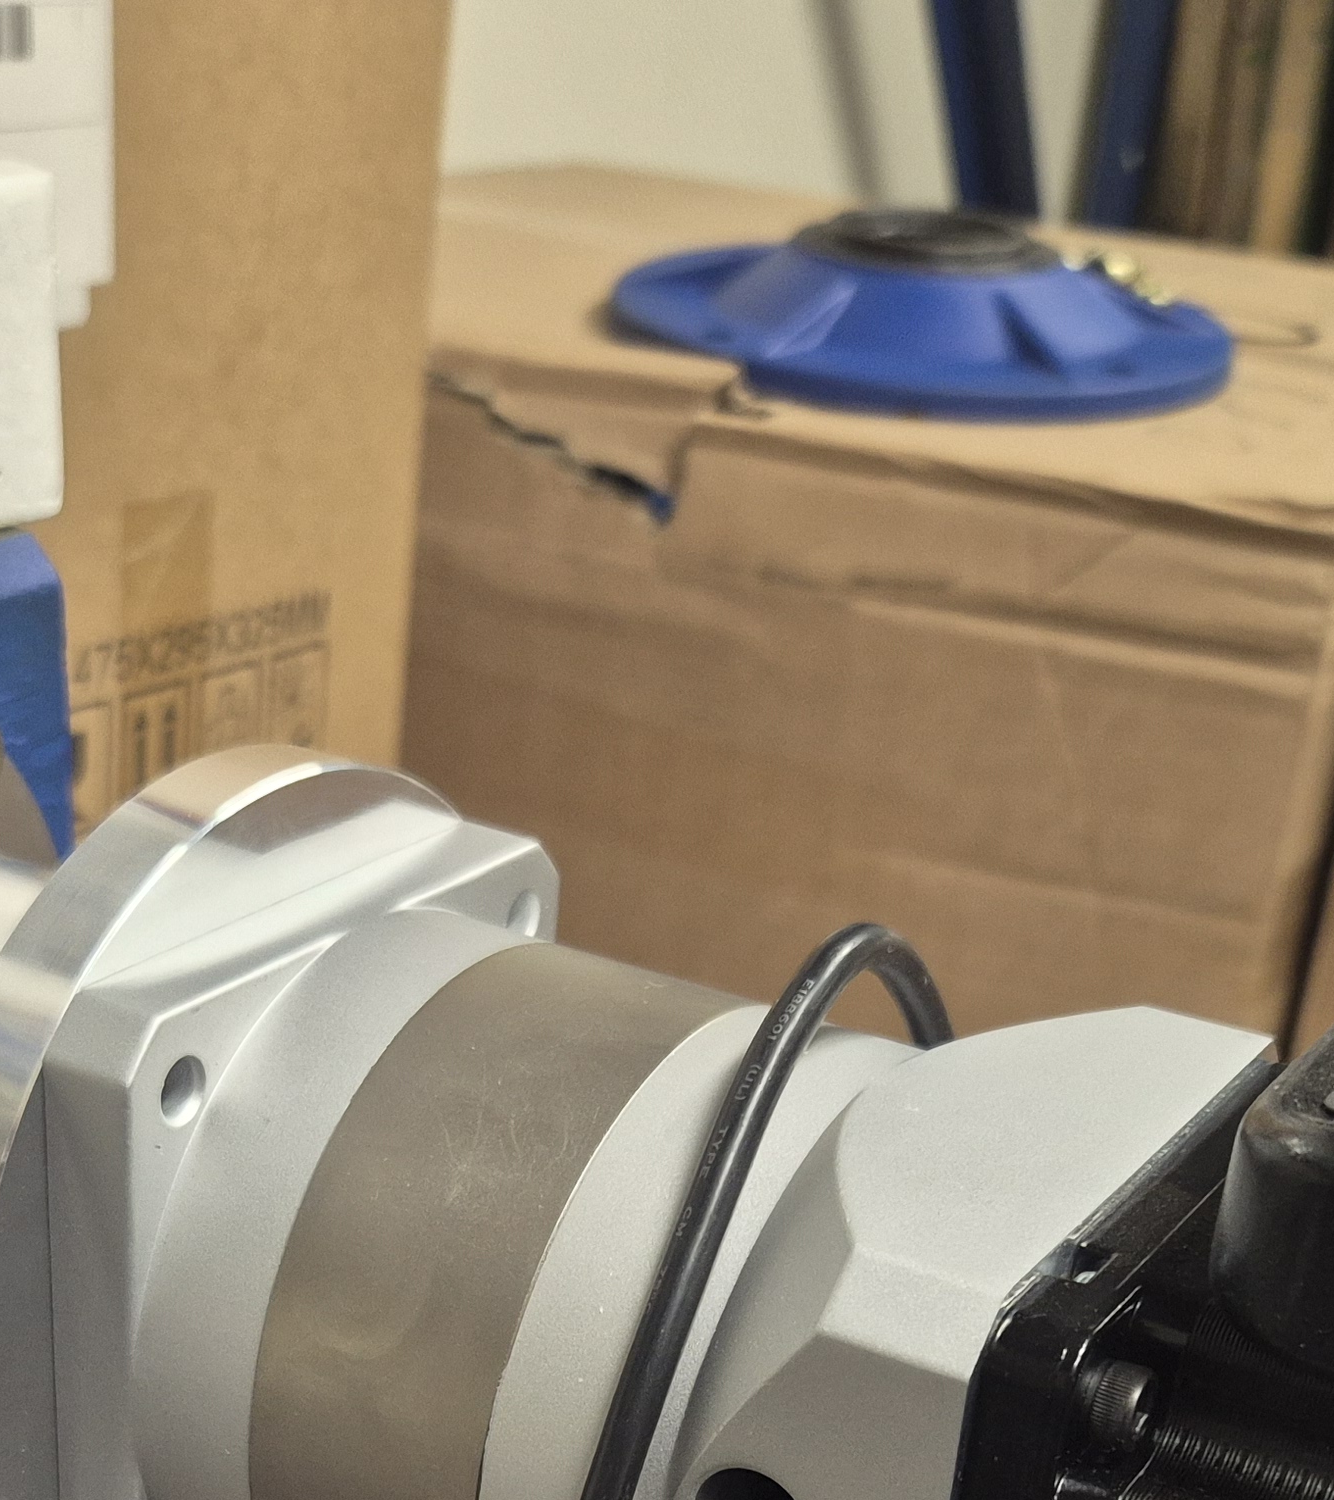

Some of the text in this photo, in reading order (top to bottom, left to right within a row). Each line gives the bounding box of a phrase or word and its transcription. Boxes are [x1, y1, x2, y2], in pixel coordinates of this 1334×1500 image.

[734, 1064, 762, 1101] (UL)
[699, 1125, 729, 1179] TYPE
[676, 1206, 692, 1237] CM
